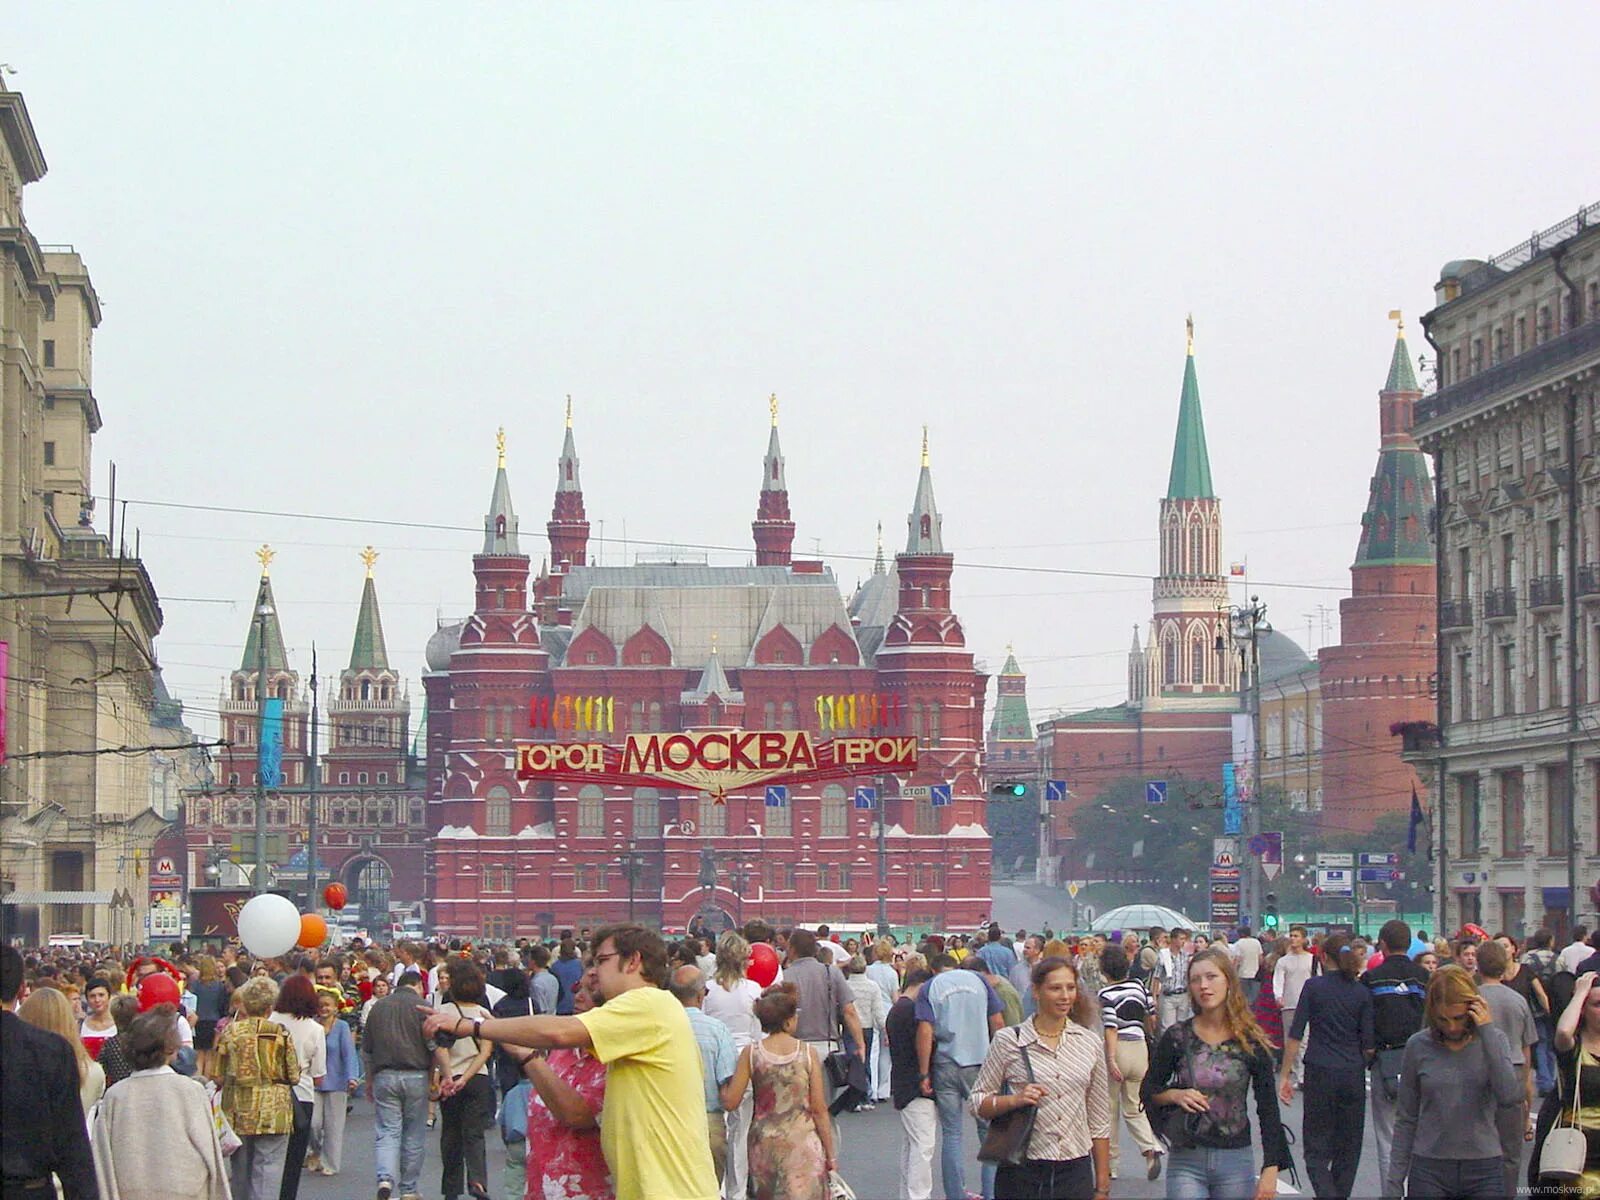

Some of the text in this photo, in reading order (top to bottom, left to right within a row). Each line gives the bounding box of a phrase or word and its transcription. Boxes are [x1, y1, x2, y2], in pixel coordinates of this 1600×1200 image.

[517, 744, 605, 772] ГОРОД
[622, 733, 815, 772] МОСКВА
[1220, 855, 1230, 864] М
[160, 861, 171, 871] М
